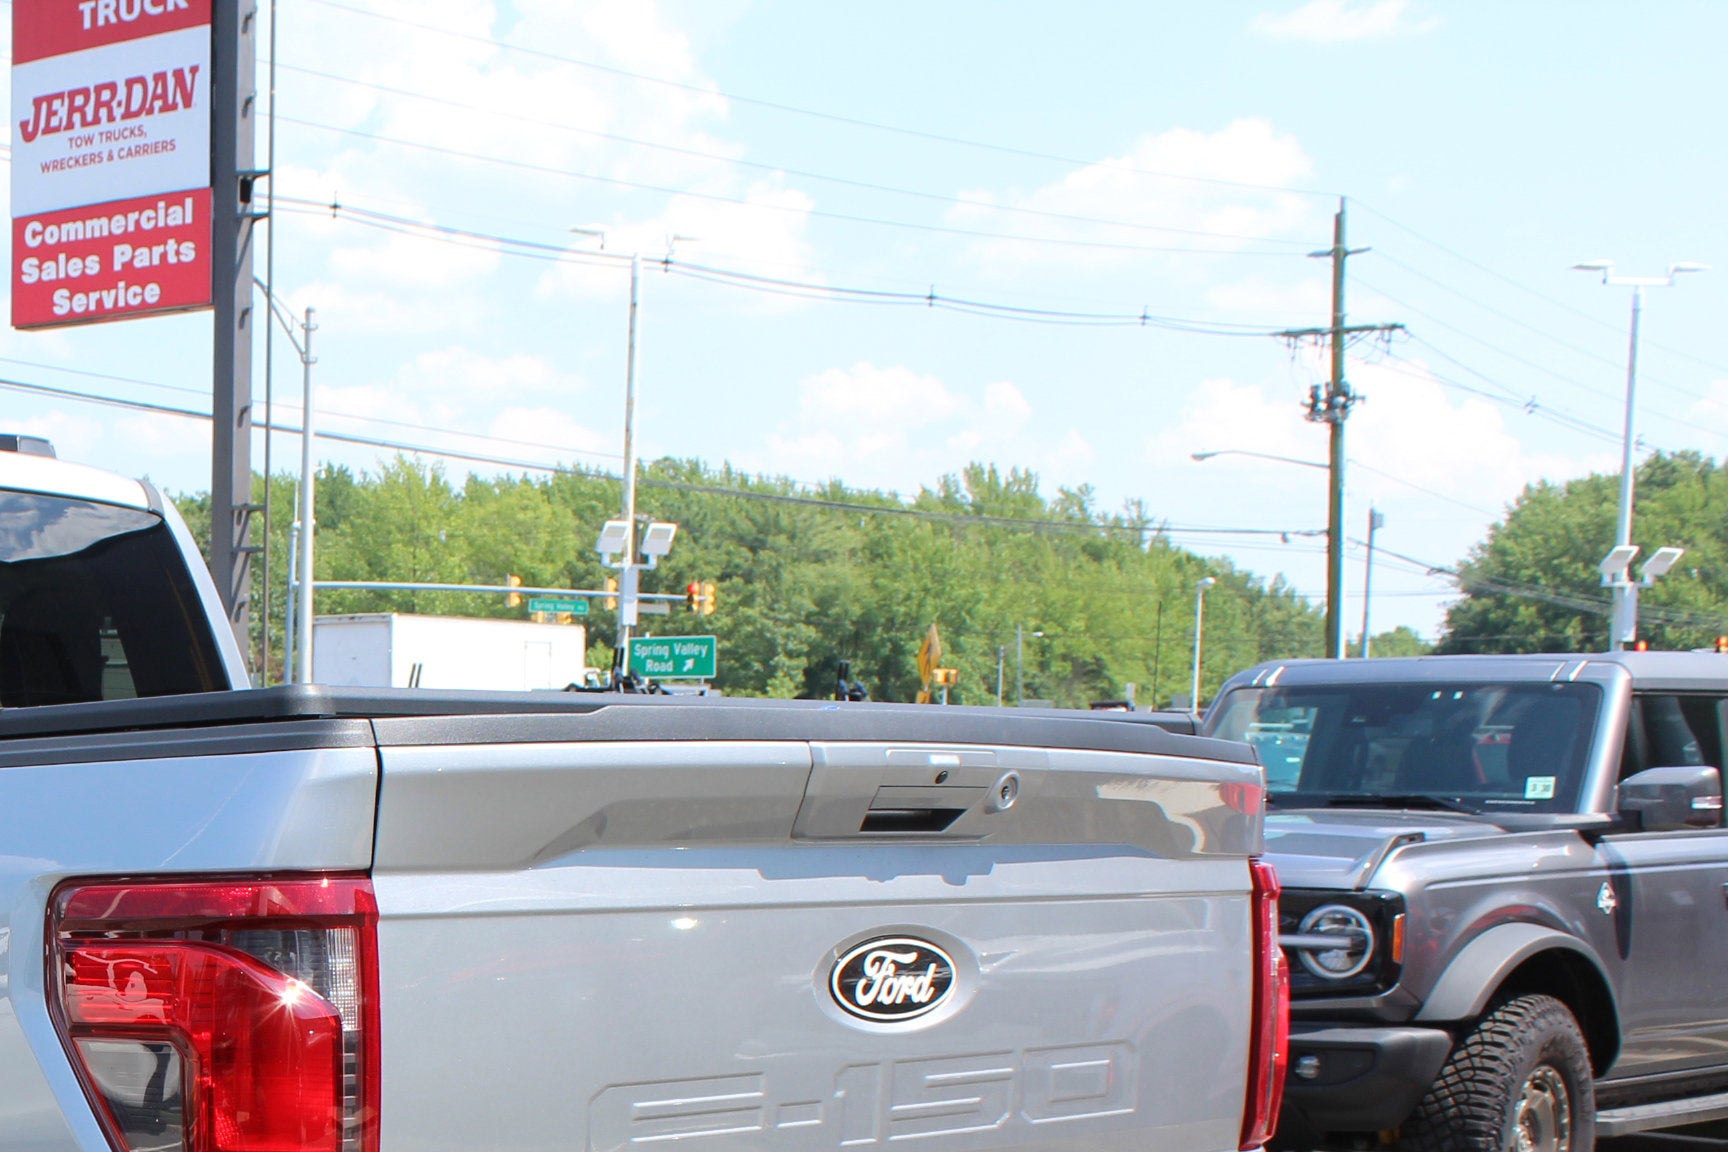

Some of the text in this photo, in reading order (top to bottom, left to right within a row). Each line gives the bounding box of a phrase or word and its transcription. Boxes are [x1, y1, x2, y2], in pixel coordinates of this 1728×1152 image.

[68, 125, 148, 149] TOW TRUCKS,
[40, 139, 176, 174] WRECKERS & CARRIERS
[24, 197, 193, 249] Commercial
[21, 238, 196, 284] Sales Parts
[52, 281, 161, 316] Service
[634, 642, 708, 660] Spring Valley
[645, 659, 673, 672] Road
[855, 950, 938, 1006] Ford
